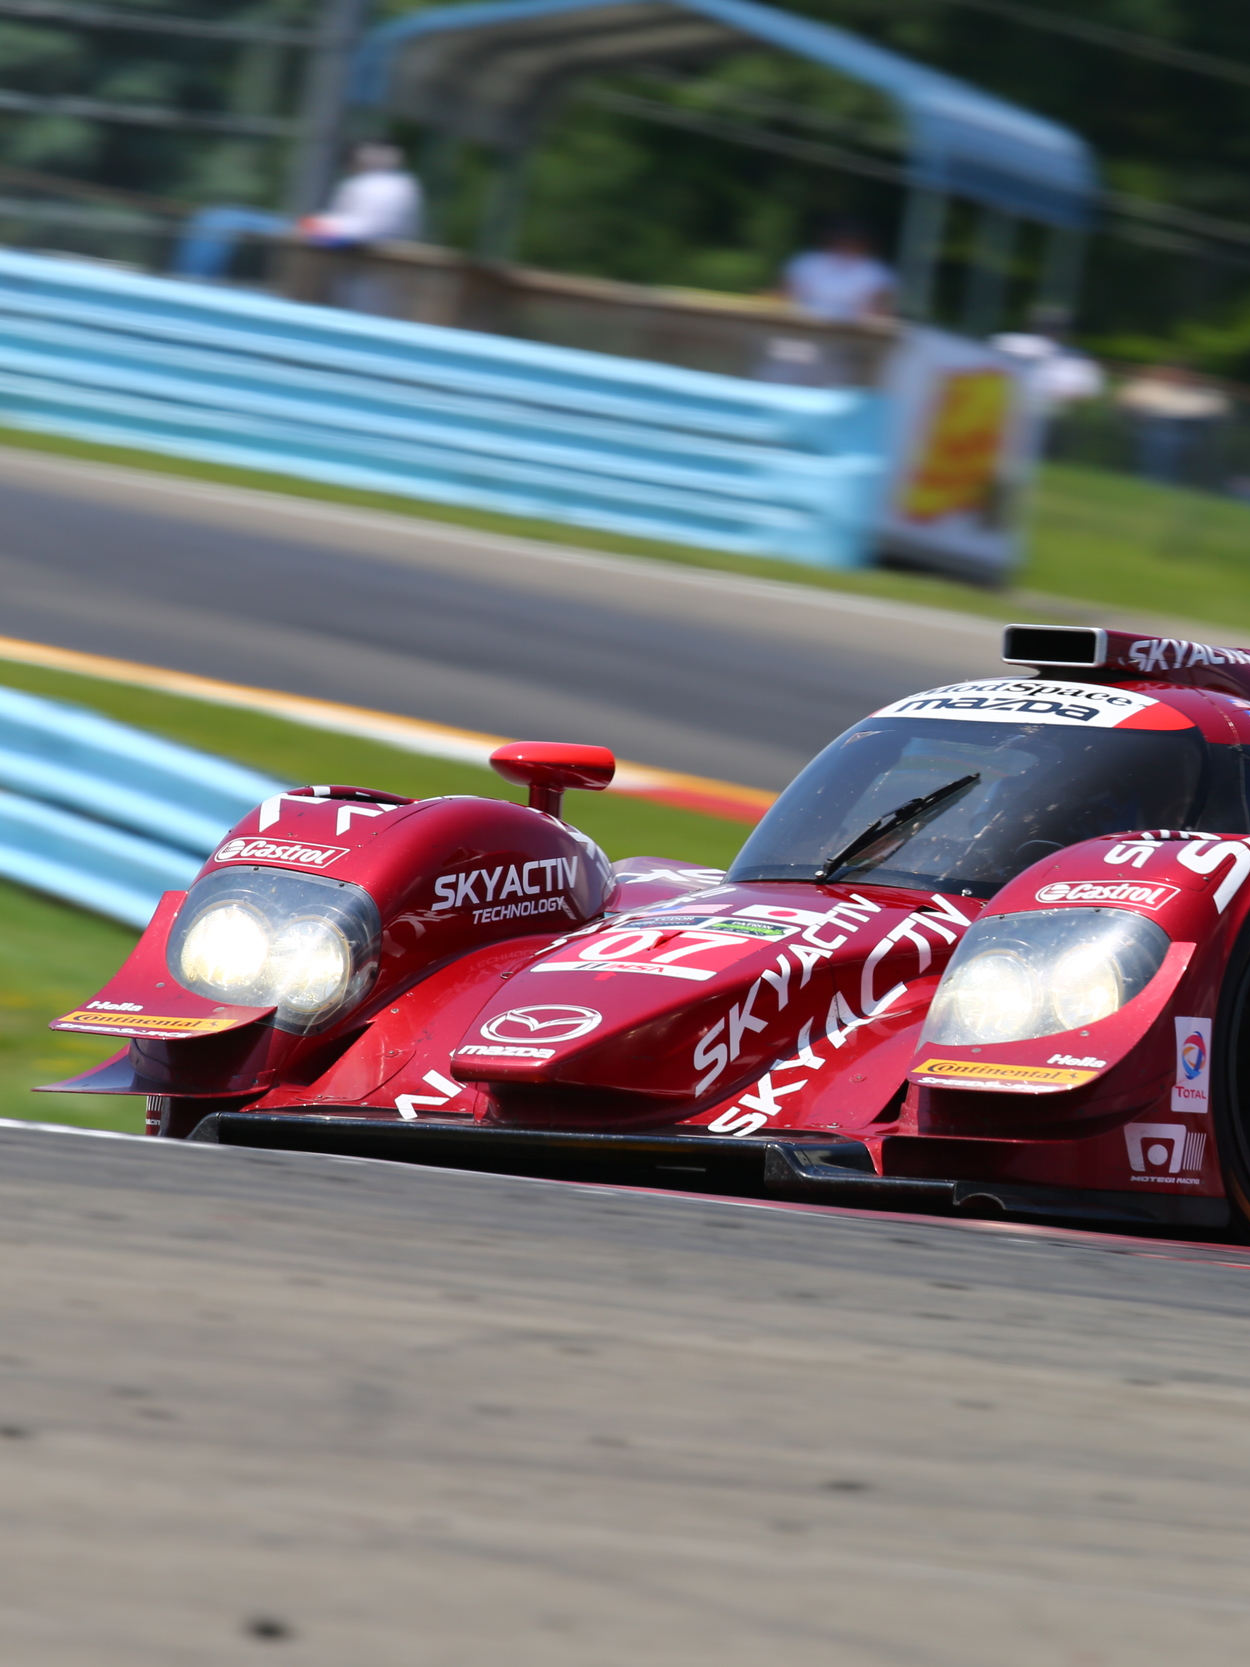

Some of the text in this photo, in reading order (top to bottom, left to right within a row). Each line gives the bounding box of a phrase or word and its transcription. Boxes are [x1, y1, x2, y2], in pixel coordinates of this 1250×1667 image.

[897, 697, 1101, 722] mazda
[243, 839, 337, 867] Castrol
[430, 856, 580, 911] SKYACTIV
[1069, 882, 1166, 907] Castrol
[472, 896, 567, 925] TECHNOLOGY
[578, 930, 750, 963] 07
[86, 1001, 143, 1012] Hella
[693, 893, 882, 1098] SKYACTIV
[73, 1014, 200, 1029] Continental
[707, 893, 973, 1138] SKYACTIV
[456, 1044, 557, 1060] mazda
[1046, 1054, 1107, 1068] Hella
[927, 1062, 1062, 1080] Continental
[1175, 1085, 1207, 1100] TOTAL
[1130, 1175, 1176, 1184] MOTEGI
